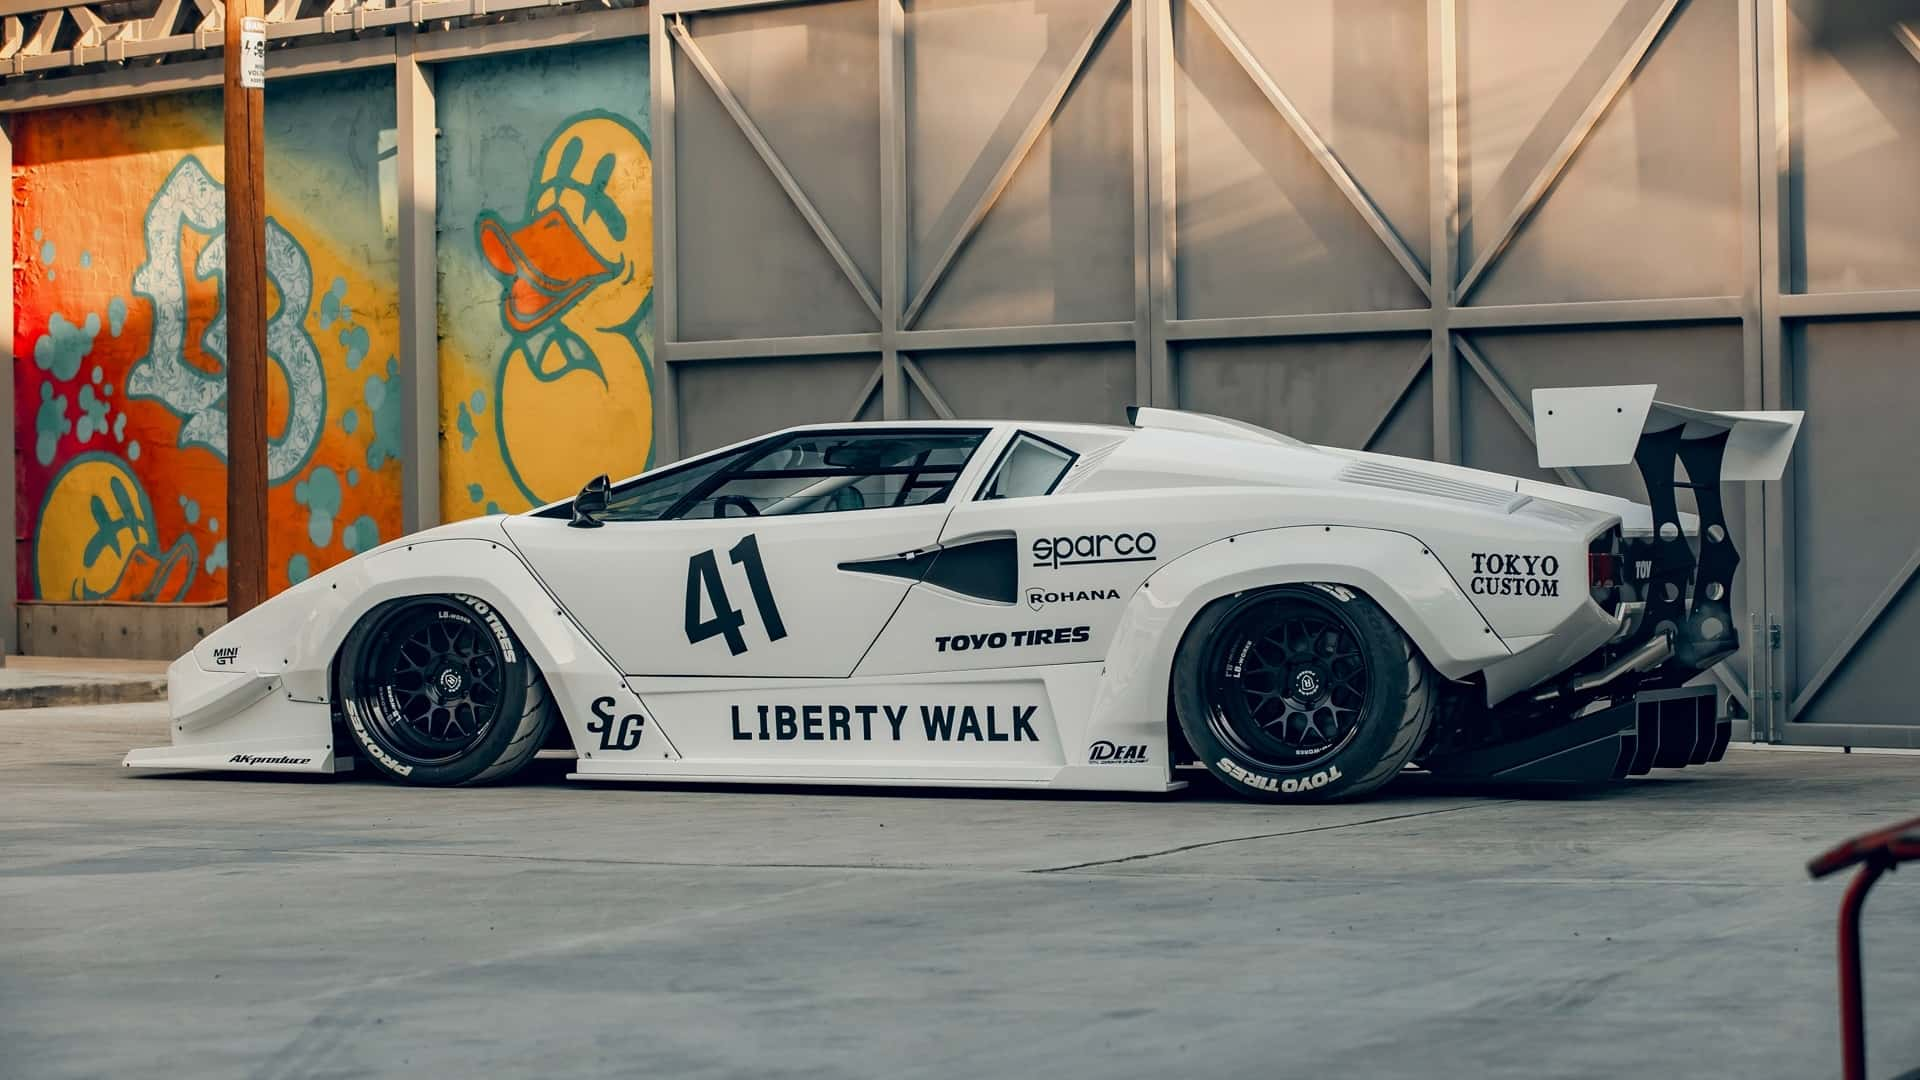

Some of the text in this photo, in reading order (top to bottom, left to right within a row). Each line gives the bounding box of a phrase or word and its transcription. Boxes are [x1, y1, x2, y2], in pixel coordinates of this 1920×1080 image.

[1033, 533, 1156, 569] sparco
[1471, 553, 1559, 576] TOKYO
[685, 533, 788, 657] 41
[1030, 589, 1121, 604] ROHANA
[1470, 577, 1559, 597] CUSTOM
[213, 647, 239, 657] MINI
[485, 611, 517, 664] TIRES
[935, 626, 1090, 652] TOYO TIRES
[216, 657, 237, 665] GT
[345, 697, 414, 777] PROXES
[587, 696, 644, 751] SLG
[731, 705, 1040, 742] LIBERTY WALK
[1216, 757, 1343, 793] TOYO TIRES
